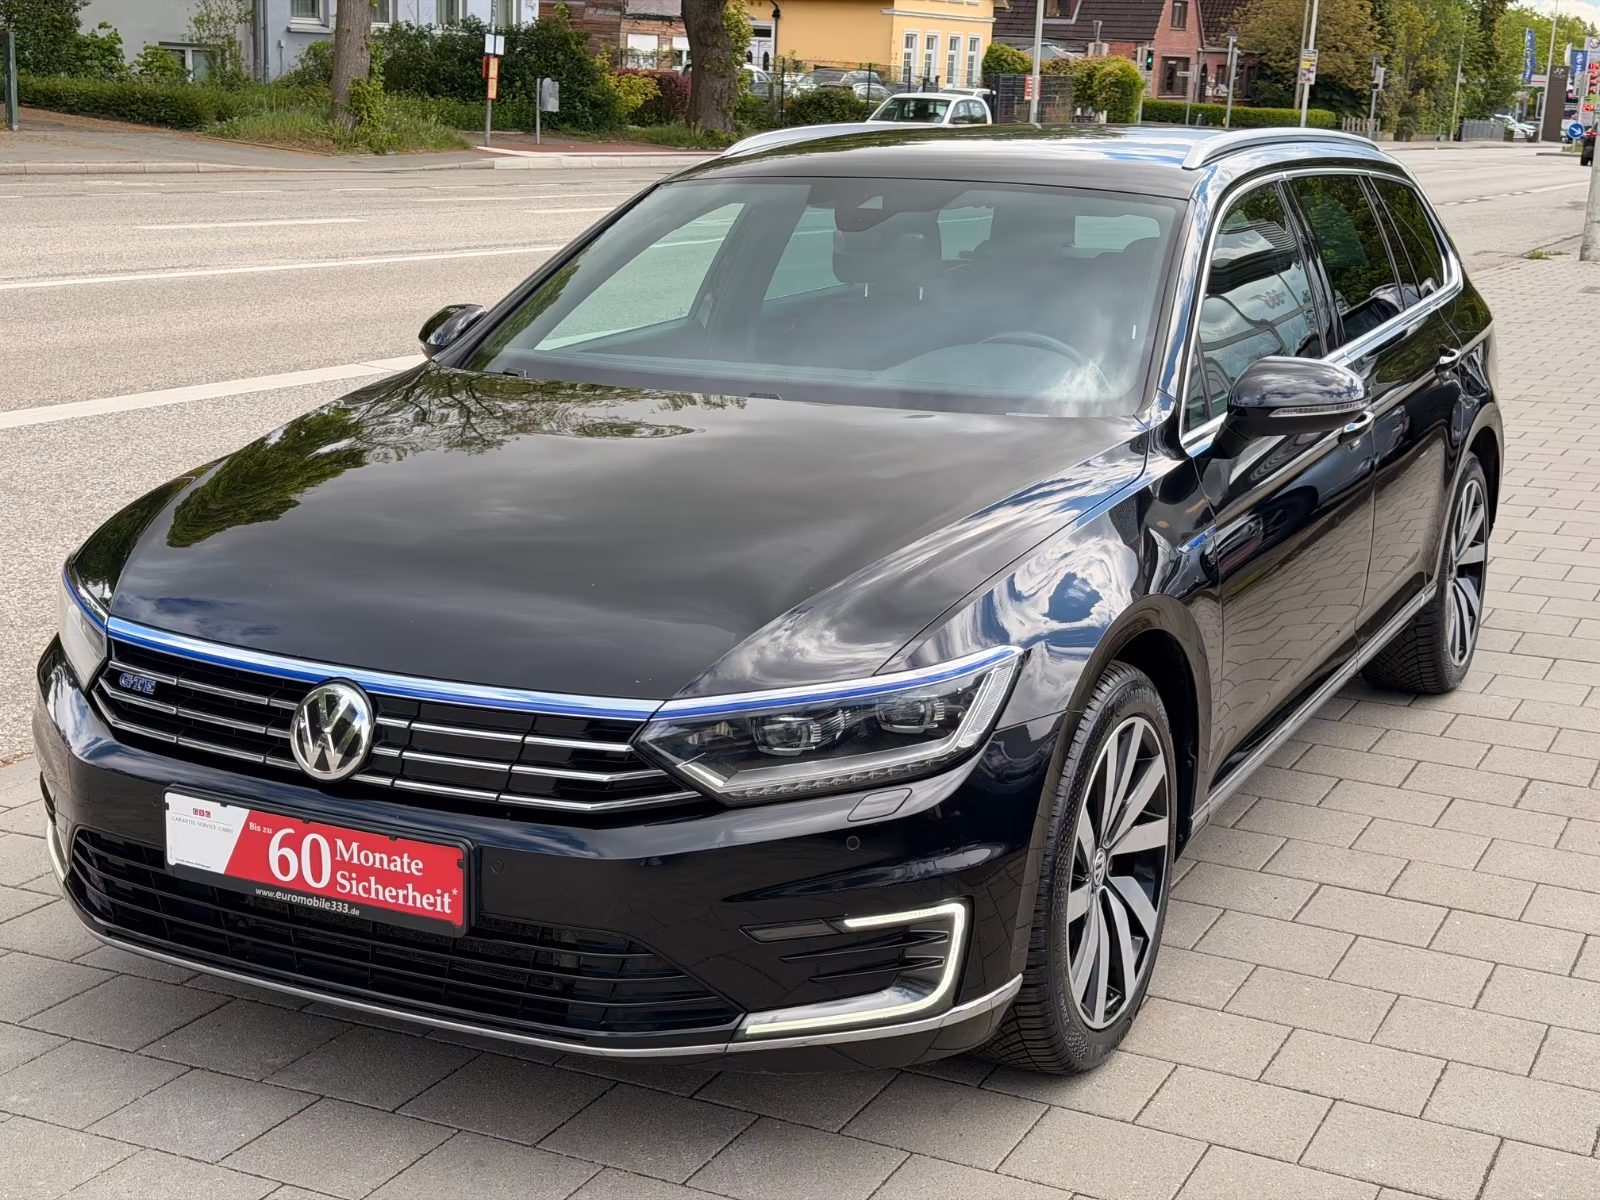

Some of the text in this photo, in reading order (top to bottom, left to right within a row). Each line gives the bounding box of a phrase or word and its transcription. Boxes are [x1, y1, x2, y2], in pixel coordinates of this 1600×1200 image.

[119, 672, 156, 695] GTE
[248, 821, 273, 835] Bis zu
[268, 827, 332, 889] 60
[334, 838, 424, 876] Monate
[255, 887, 360, 916] www.euromobile333.de
